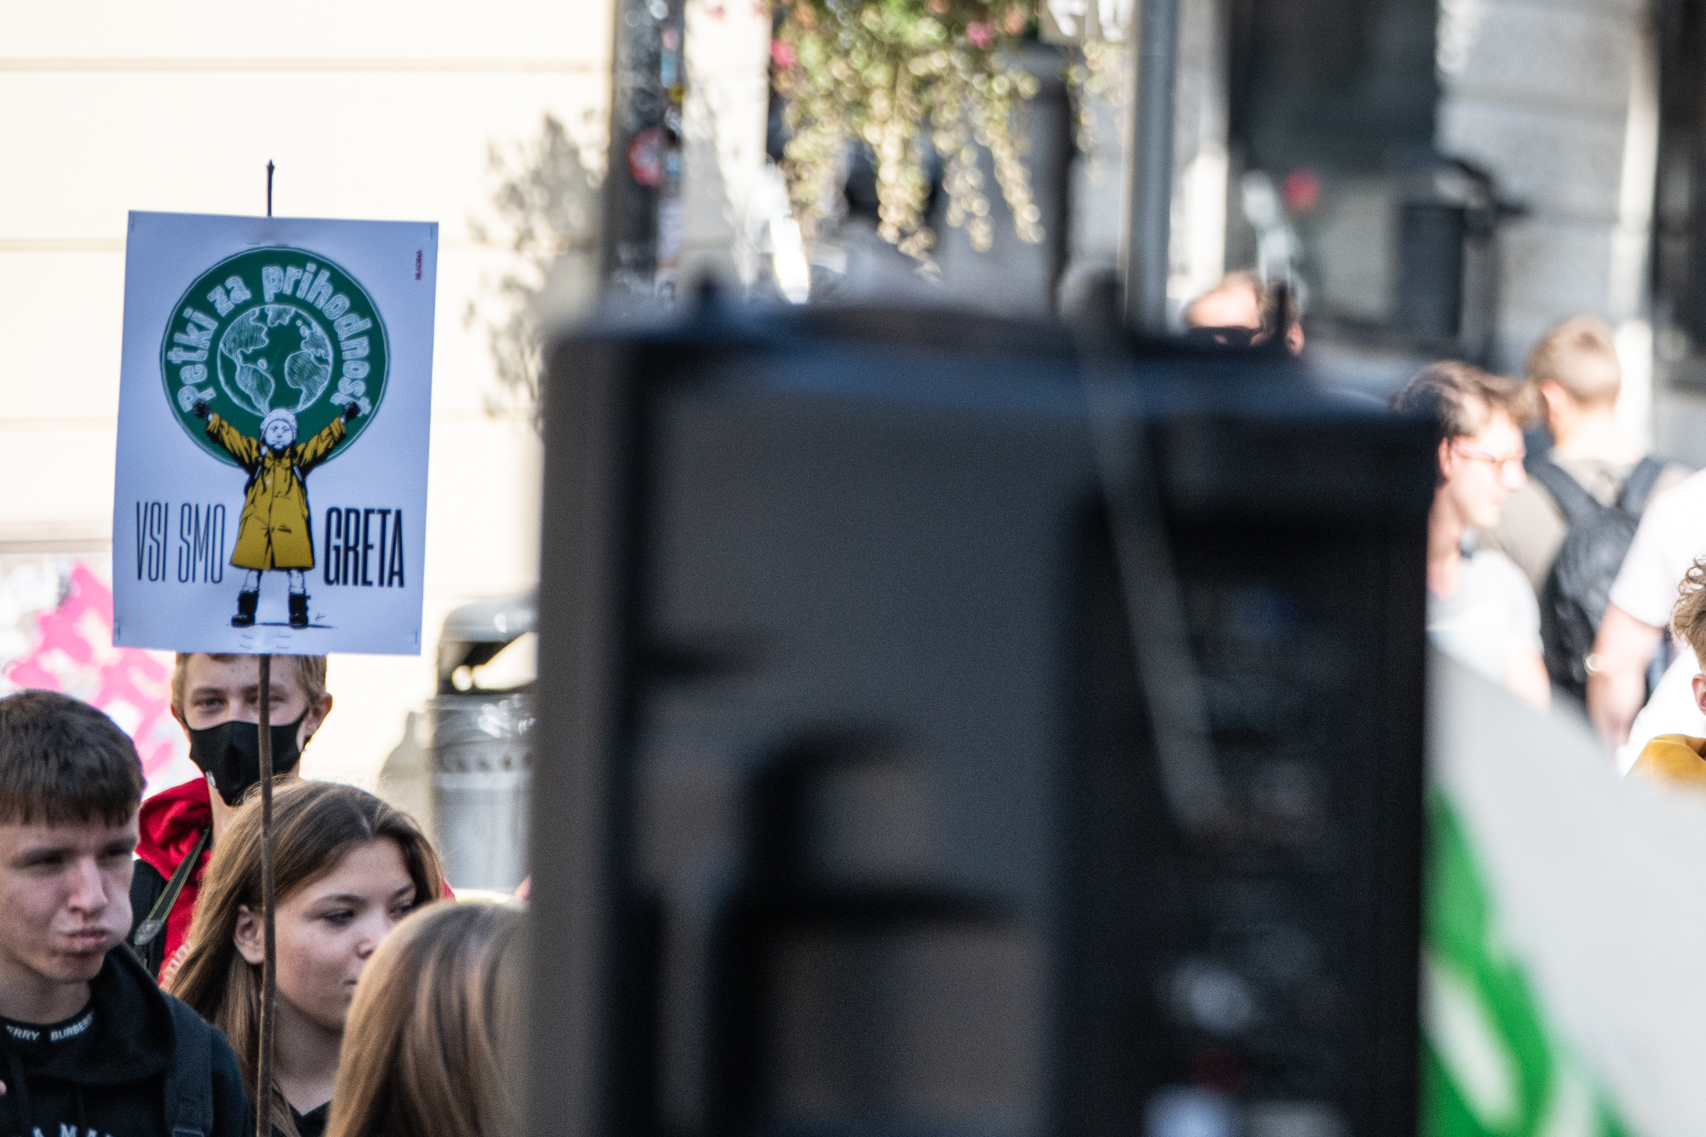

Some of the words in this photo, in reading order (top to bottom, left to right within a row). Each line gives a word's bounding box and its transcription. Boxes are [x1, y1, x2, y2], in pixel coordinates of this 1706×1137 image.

[206, 275, 252, 317] za
[261, 262, 373, 417] prihodnost
[136, 501, 169, 582] VSI
[178, 503, 227, 584] SMO
[322, 507, 405, 588] GRETA
